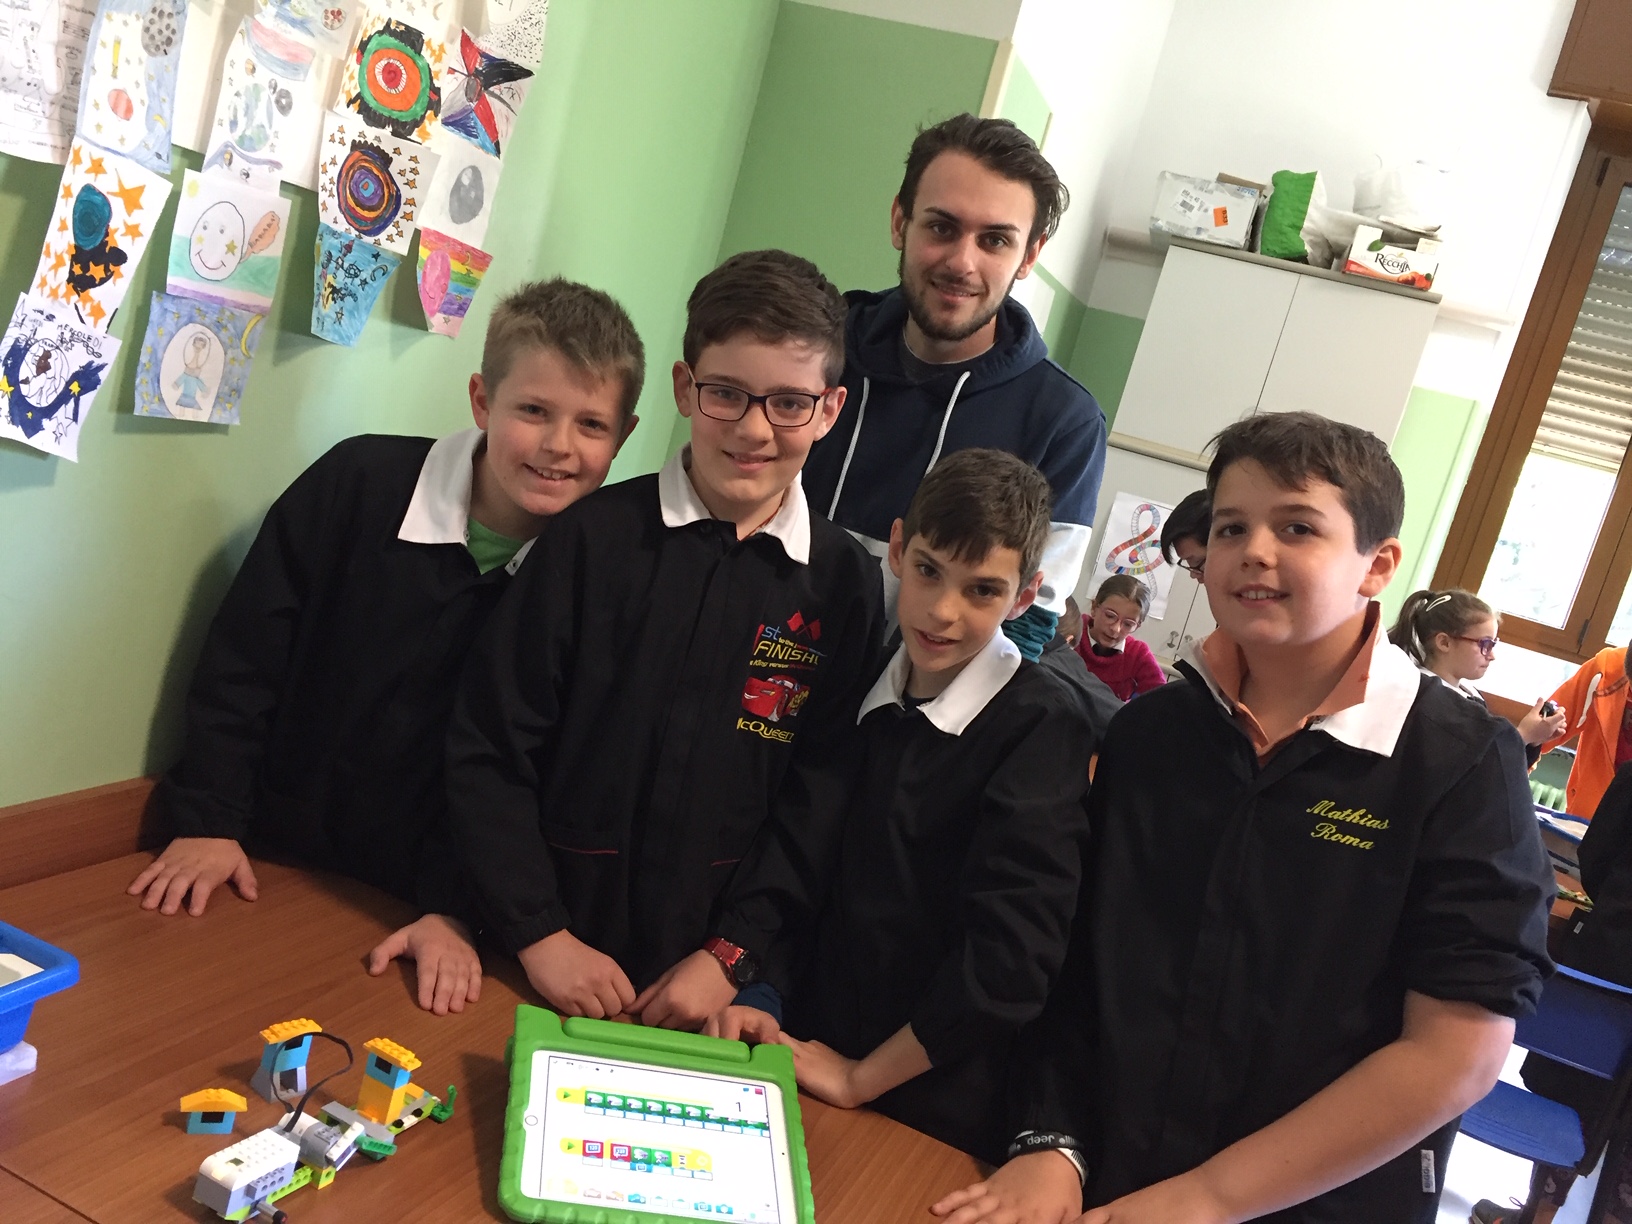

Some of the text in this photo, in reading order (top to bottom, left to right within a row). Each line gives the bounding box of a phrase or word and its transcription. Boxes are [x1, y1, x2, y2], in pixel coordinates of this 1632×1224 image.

[1374, 253, 1411, 274] RECCHIA
[1306, 800, 1389, 829] Mathias
[1310, 822, 1374, 850] Roma
